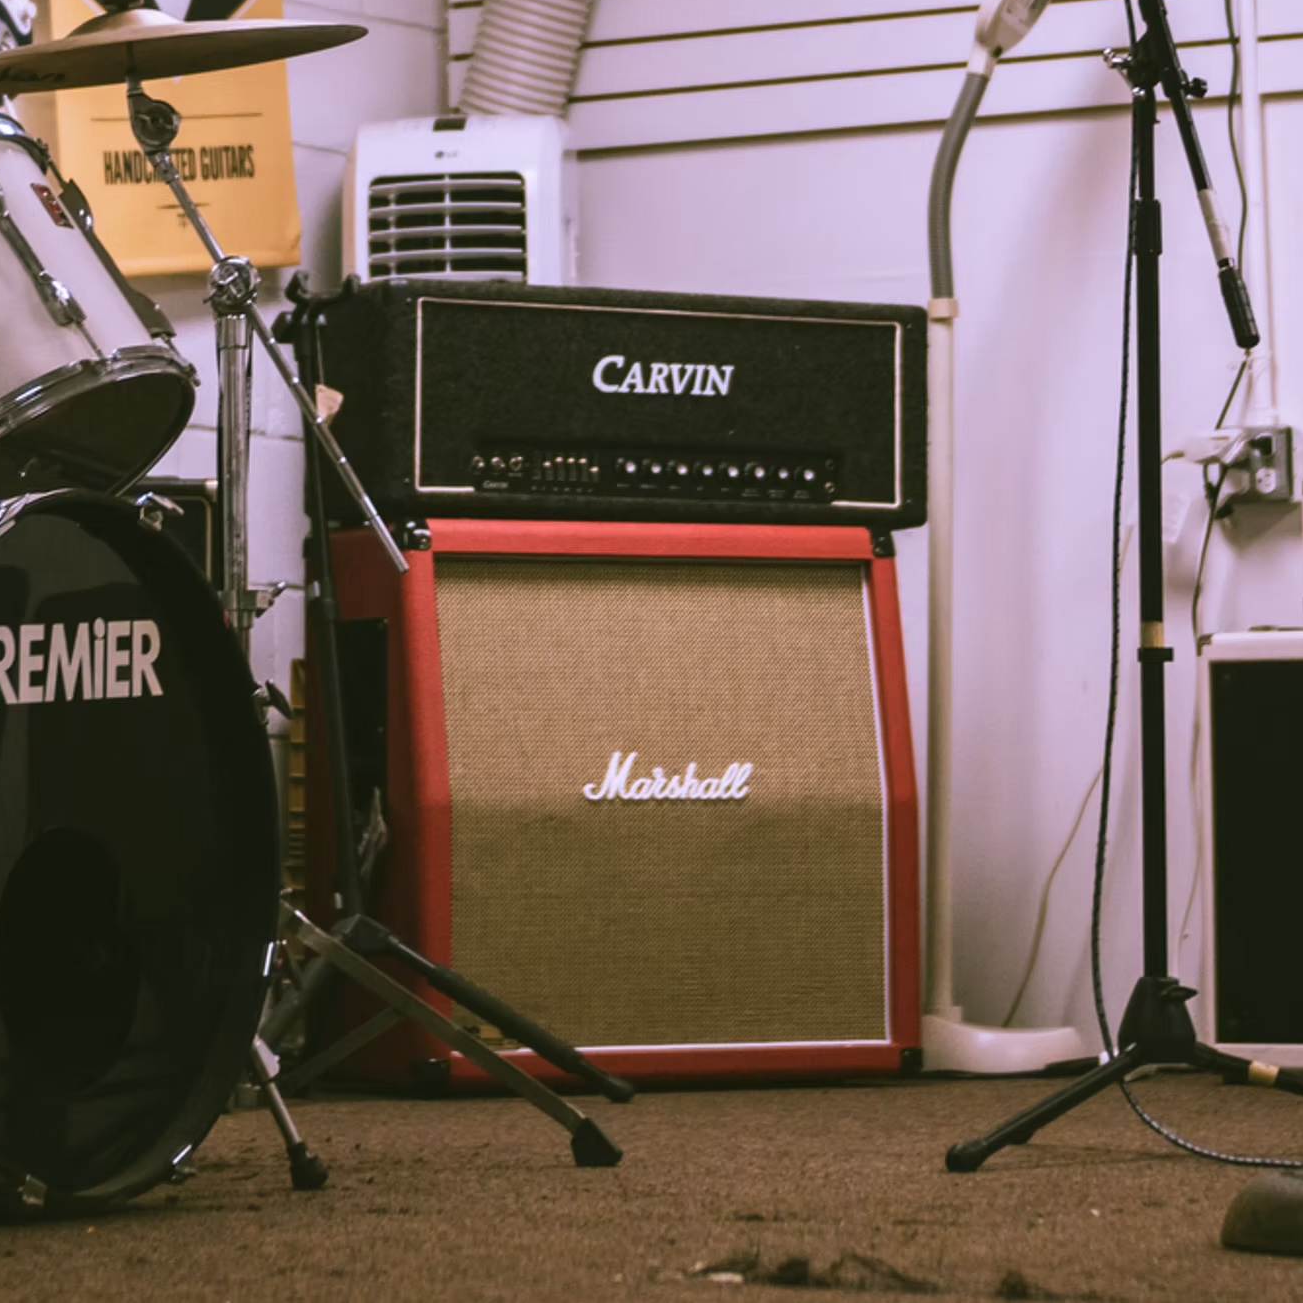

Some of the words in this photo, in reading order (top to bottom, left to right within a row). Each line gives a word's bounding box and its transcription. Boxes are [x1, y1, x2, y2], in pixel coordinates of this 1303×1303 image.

[200, 144, 256, 182] GUITARS
[592, 354, 736, 396] CARVIN
[583, 751, 754, 801] Marshall
